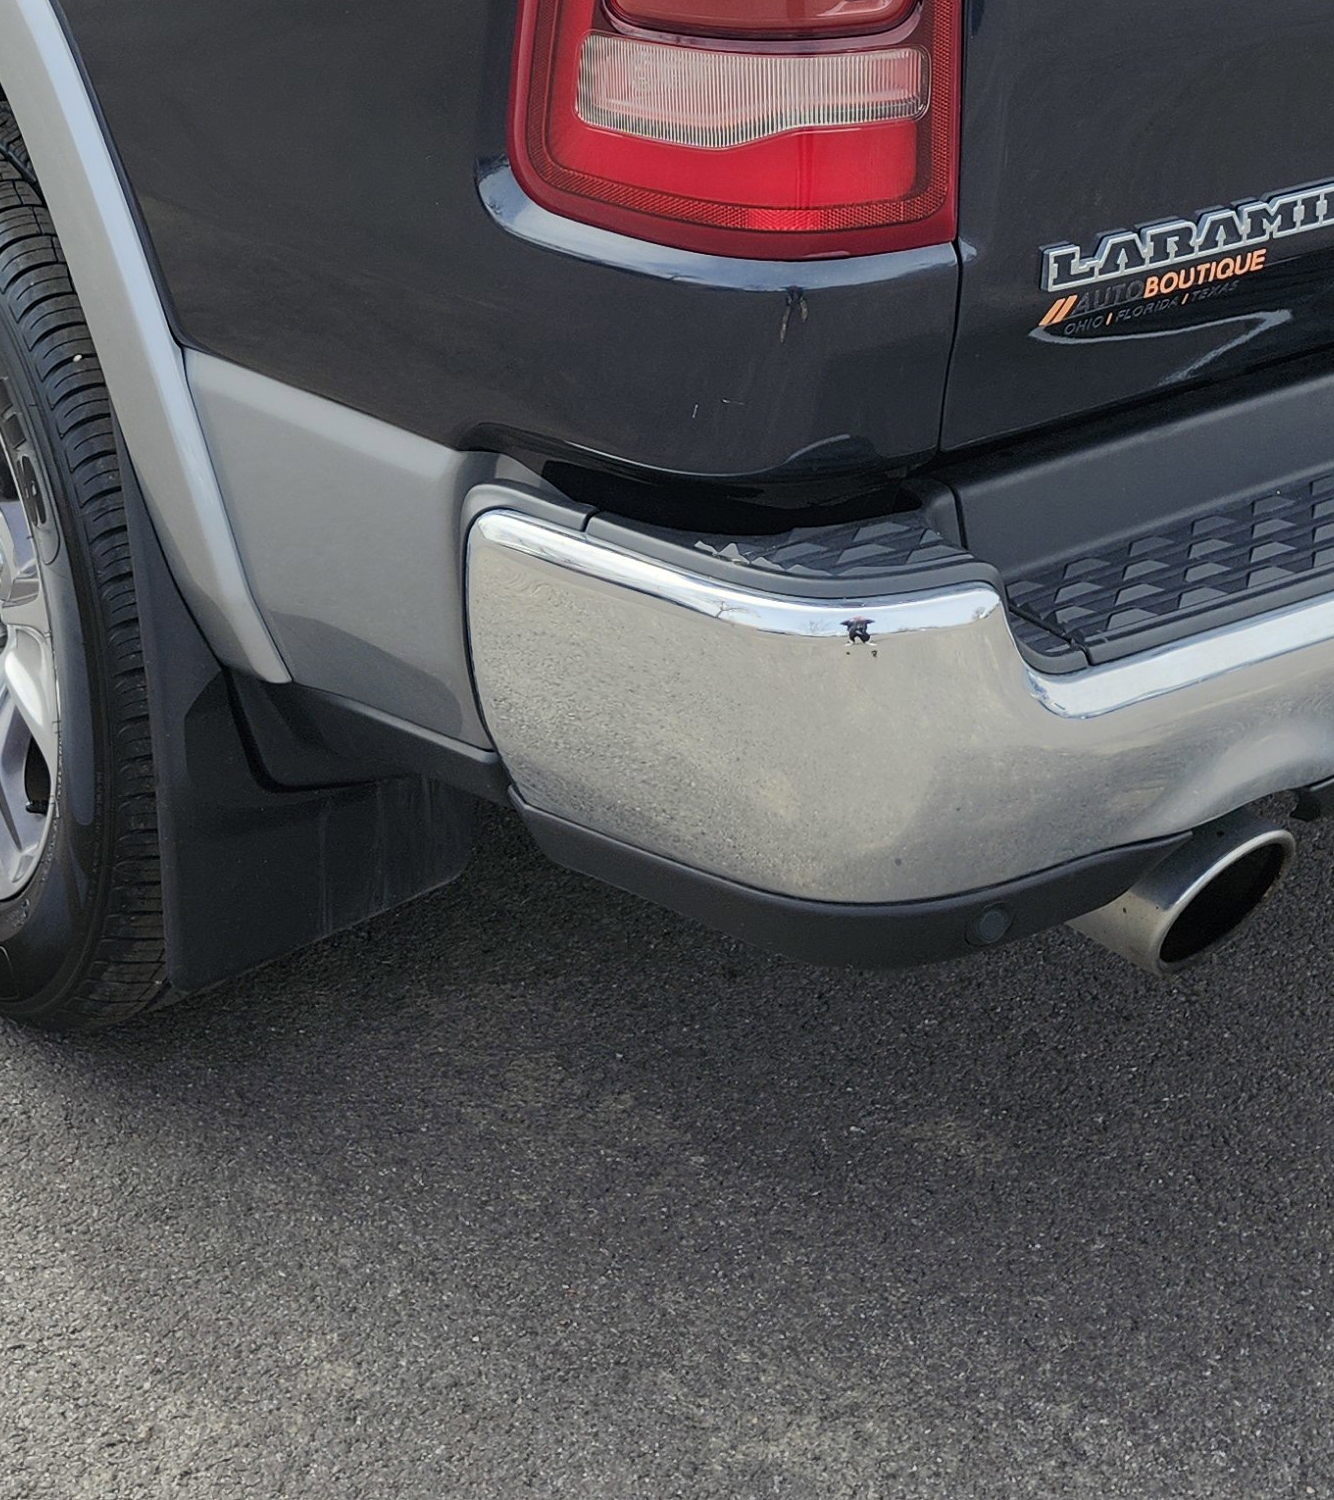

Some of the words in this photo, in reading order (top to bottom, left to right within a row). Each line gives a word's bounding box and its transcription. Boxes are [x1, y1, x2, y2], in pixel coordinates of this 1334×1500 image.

[1064, 315, 1105, 336] OHIO
[1115, 298, 1178, 323] FLORIDA
[1191, 279, 1241, 301] TEXAS
